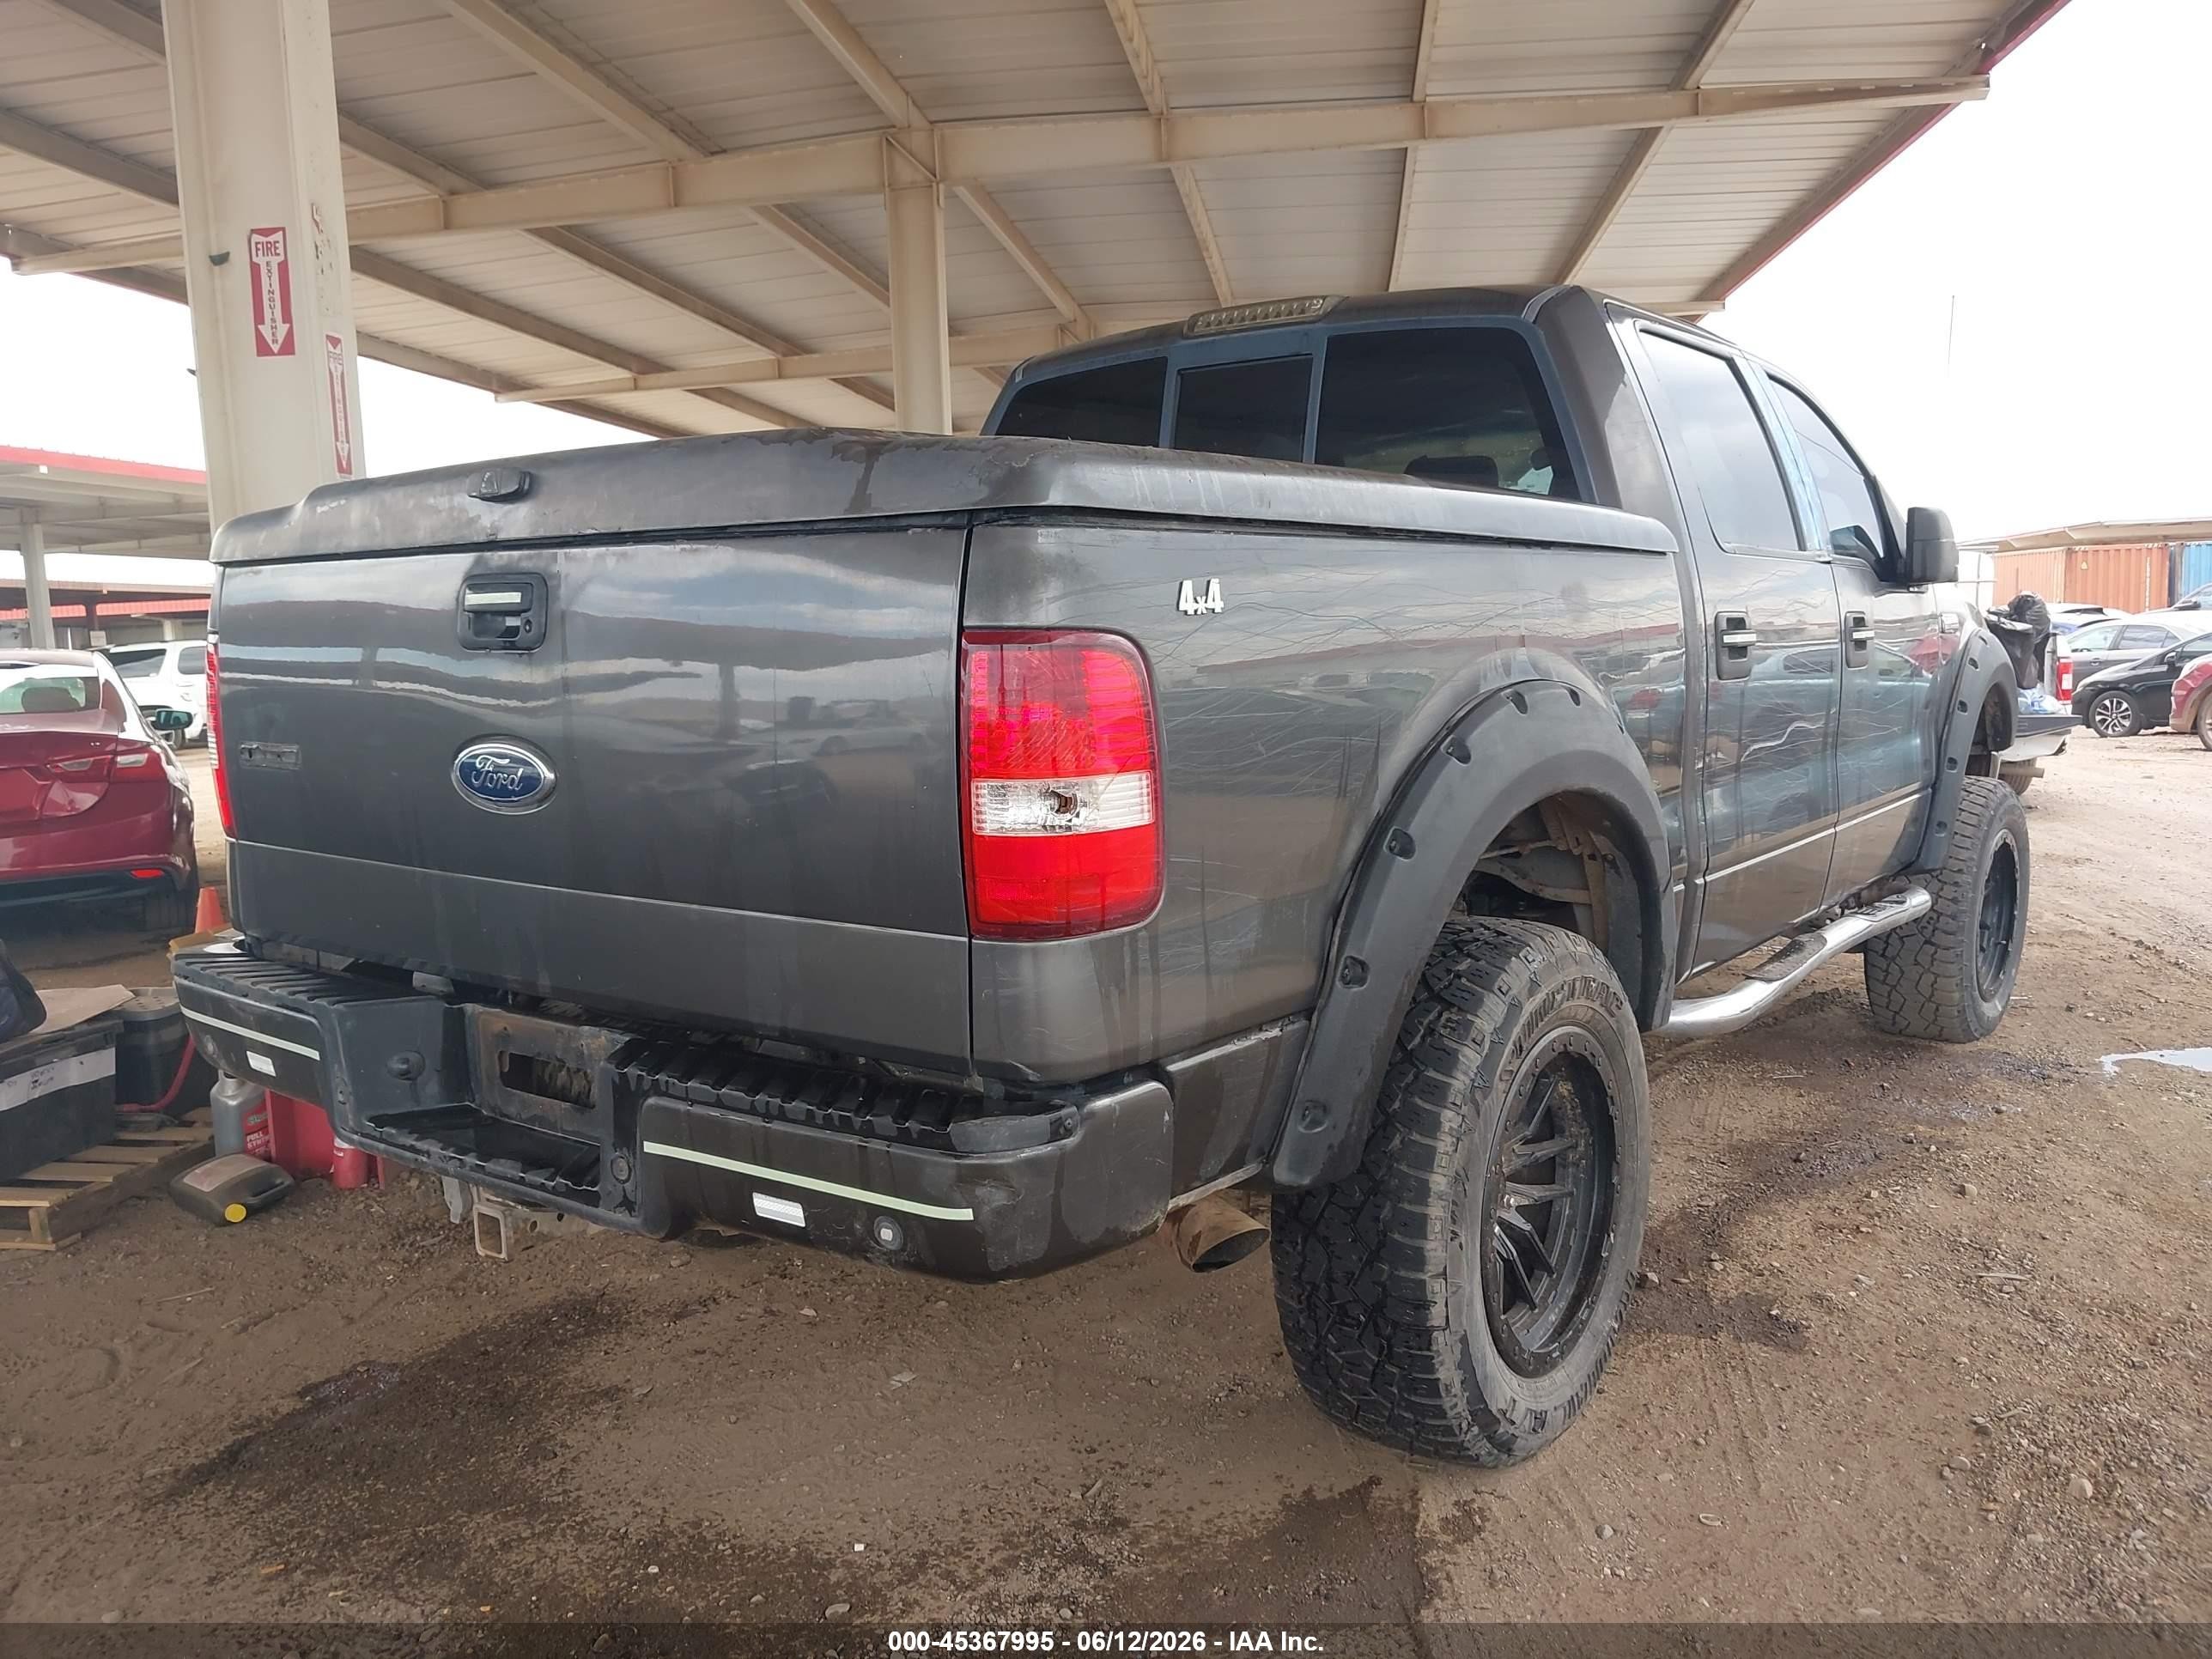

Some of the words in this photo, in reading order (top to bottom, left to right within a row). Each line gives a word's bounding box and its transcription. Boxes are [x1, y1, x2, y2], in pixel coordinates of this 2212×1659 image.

[254, 240, 282, 258] FIRE
[265, 260, 279, 345] EXTINGUISHER
[471, 755, 524, 791] Ford
